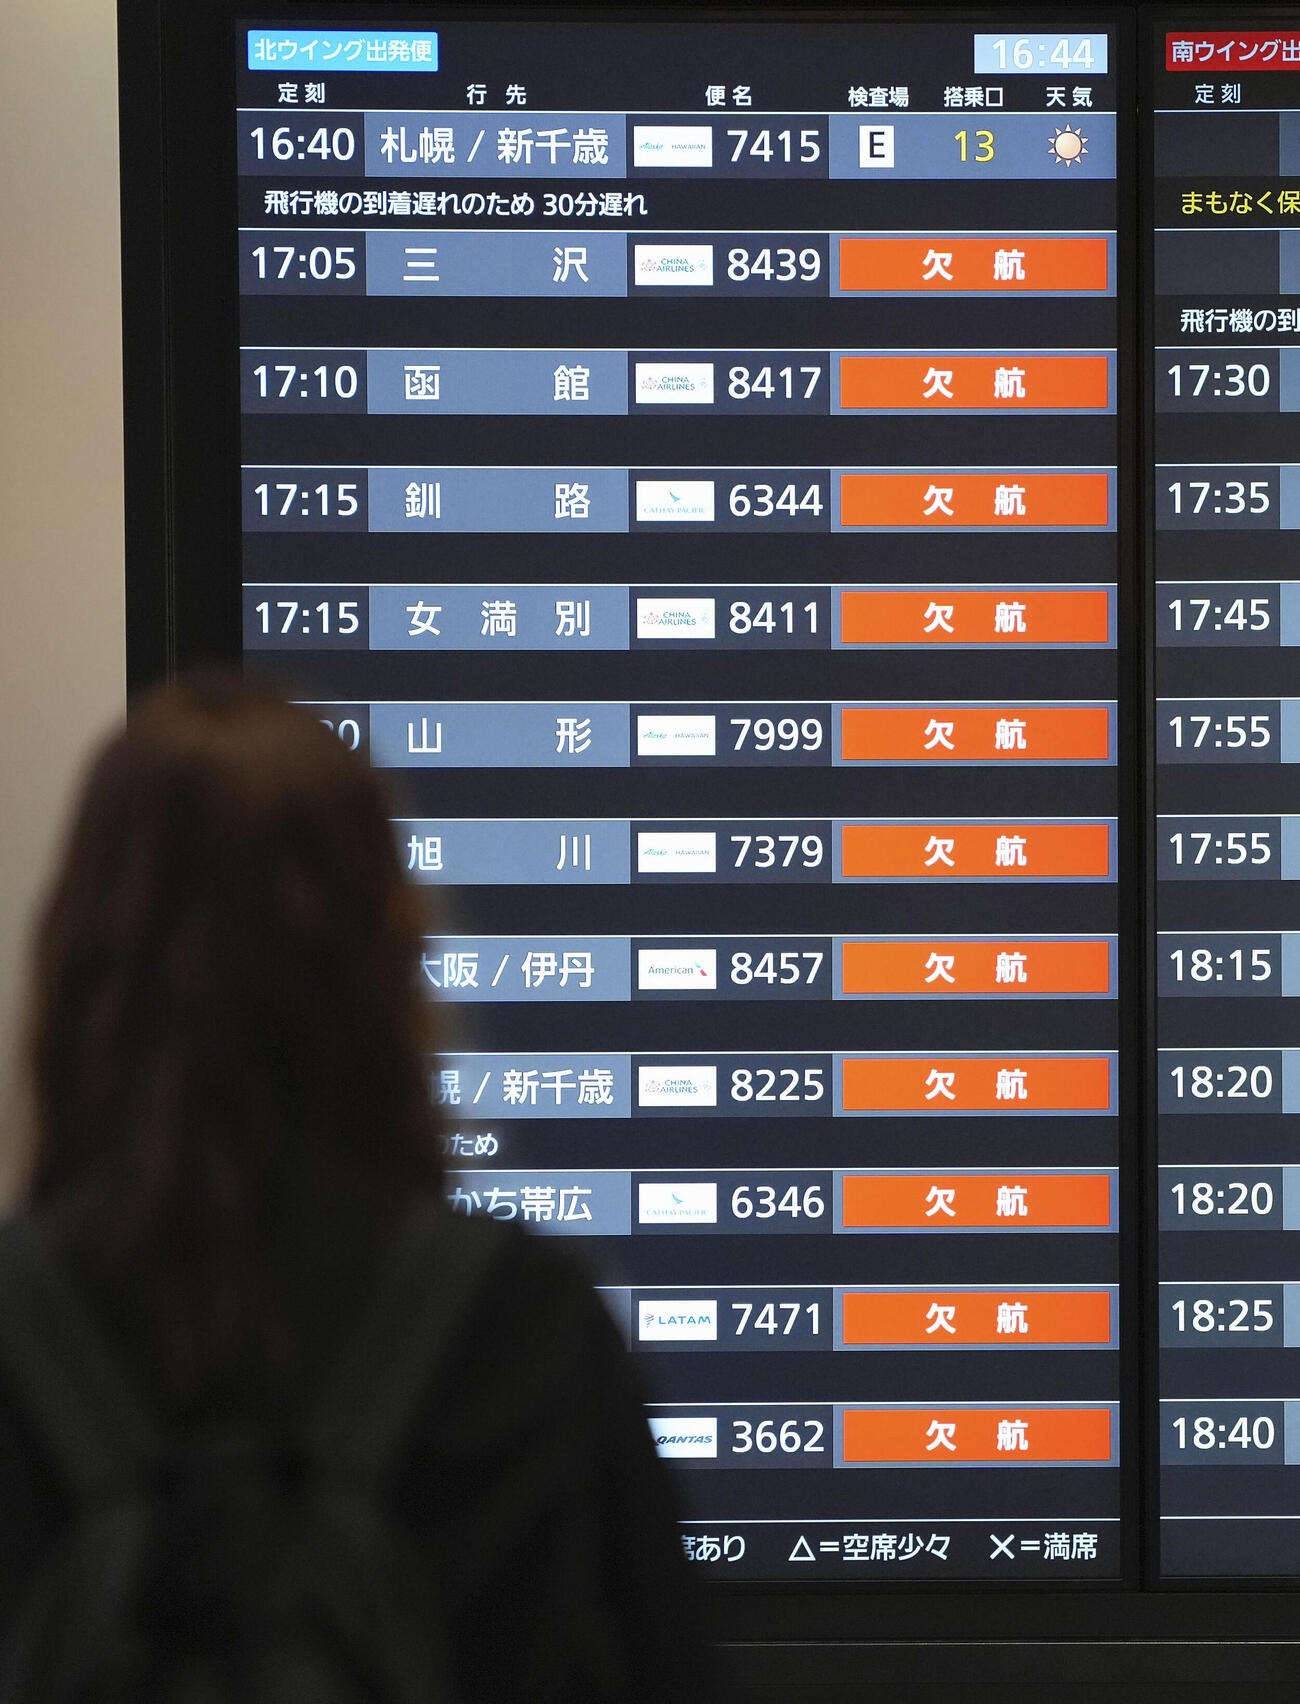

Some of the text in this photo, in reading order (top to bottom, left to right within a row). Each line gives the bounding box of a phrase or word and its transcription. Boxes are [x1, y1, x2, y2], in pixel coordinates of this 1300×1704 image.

[256, 39, 431, 61] 北ウイング出発便
[993, 39, 1094, 68] 16:44
[279, 82, 325, 103] 定刻
[467, 84, 526, 104] 行先
[706, 86, 751, 106] 便名
[848, 87, 908, 107] 検査場
[944, 87, 1003, 107] 搭乗口
[1047, 87, 1092, 107] 天気
[1195, 84, 1240, 103] 定刻
[251, 128, 354, 160] 16:40
[381, 127, 455, 163] 札幌
[498, 128, 608, 164] 新千歳
[728, 131, 819, 162] 7415
[870, 130, 886, 158] E
[955, 131, 993, 161] 13
[265, 191, 647, 216] 飛行機の到着遅れのため 30分遅れ
[252, 247, 355, 279] 17:05
[728, 249, 820, 280] 8439
[254, 366, 357, 398] 17:10
[657, 383, 695, 391] AIRLINES
[729, 367, 820, 398] 8417
[1168, 365, 1269, 396] 17:30
[255, 484, 357, 515] 17:15
[730, 485, 823, 516] 6344
[1169, 482, 1269, 513] 17:35
[256, 602, 358, 633] 17:15
[658, 618, 697, 626] AIRLINES
[730, 602, 816, 633] 8411
[1169, 599, 1269, 630] 17:45
[731, 719, 822, 750] 7999
[1170, 716, 1270, 747] 17:55
[731, 836, 822, 867] 7379
[1170, 833, 1270, 864] 17:55
[522, 952, 594, 987] 伊丹
[648, 966, 693, 975] American
[731, 953, 823, 984] 8457
[1171, 950, 1271, 981] 18:15
[504, 1069, 613, 1104] 新千歳
[660, 1086, 698, 1094] AIRLINES
[731, 1070, 823, 1101] 8225
[1171, 1066, 1272, 1097] 18:20
[732, 1186, 824, 1218] 6346
[1172, 1183, 1272, 1214] 18:20
[658, 1316, 711, 1325] LATAM
[732, 1304, 818, 1334] 7471
[1173, 1300, 1273, 1331] 18:25
[656, 1436, 713, 1445] QANTAS
[733, 1421, 824, 1452] 3662
[1173, 1417, 1274, 1449] 18:40
